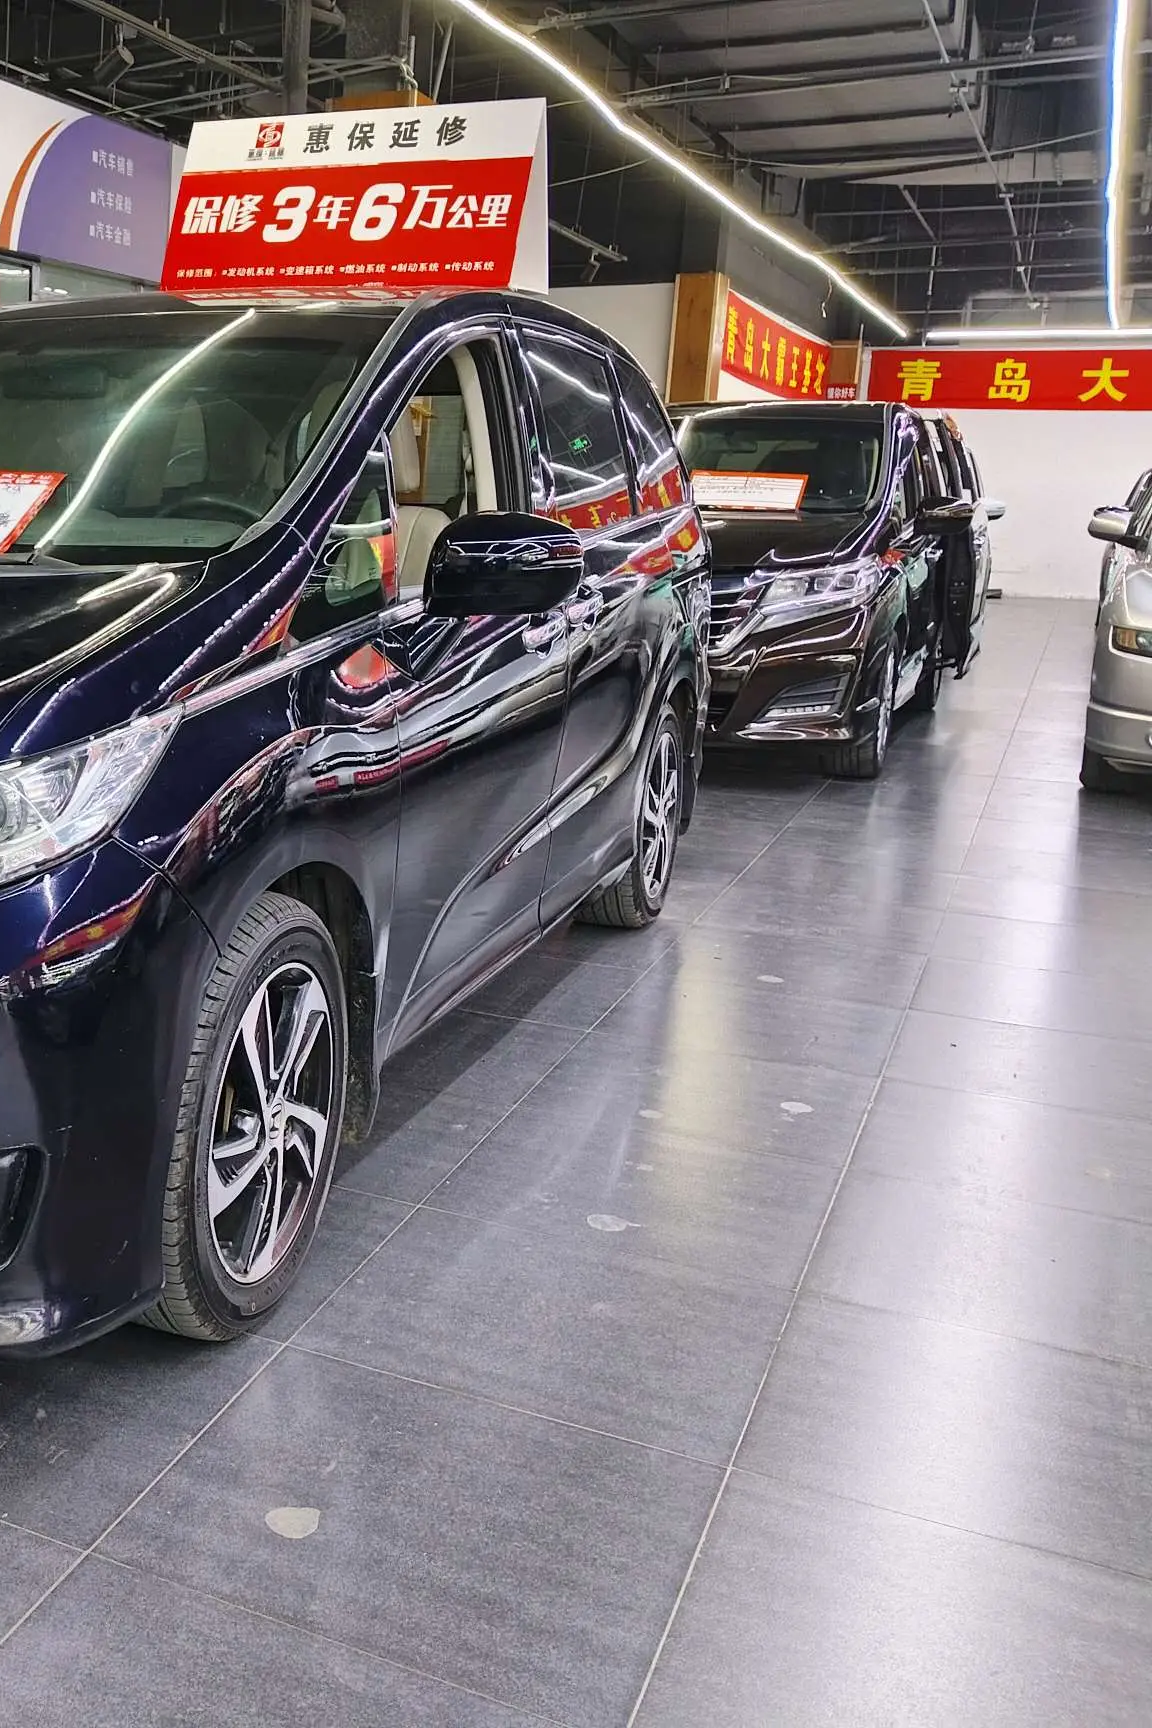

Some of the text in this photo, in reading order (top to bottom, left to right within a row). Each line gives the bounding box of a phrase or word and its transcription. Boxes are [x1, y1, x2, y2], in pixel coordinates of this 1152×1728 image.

[303, 116, 467, 153] 惠保延修
[180, 182, 513, 243] 保修3年6万公里
